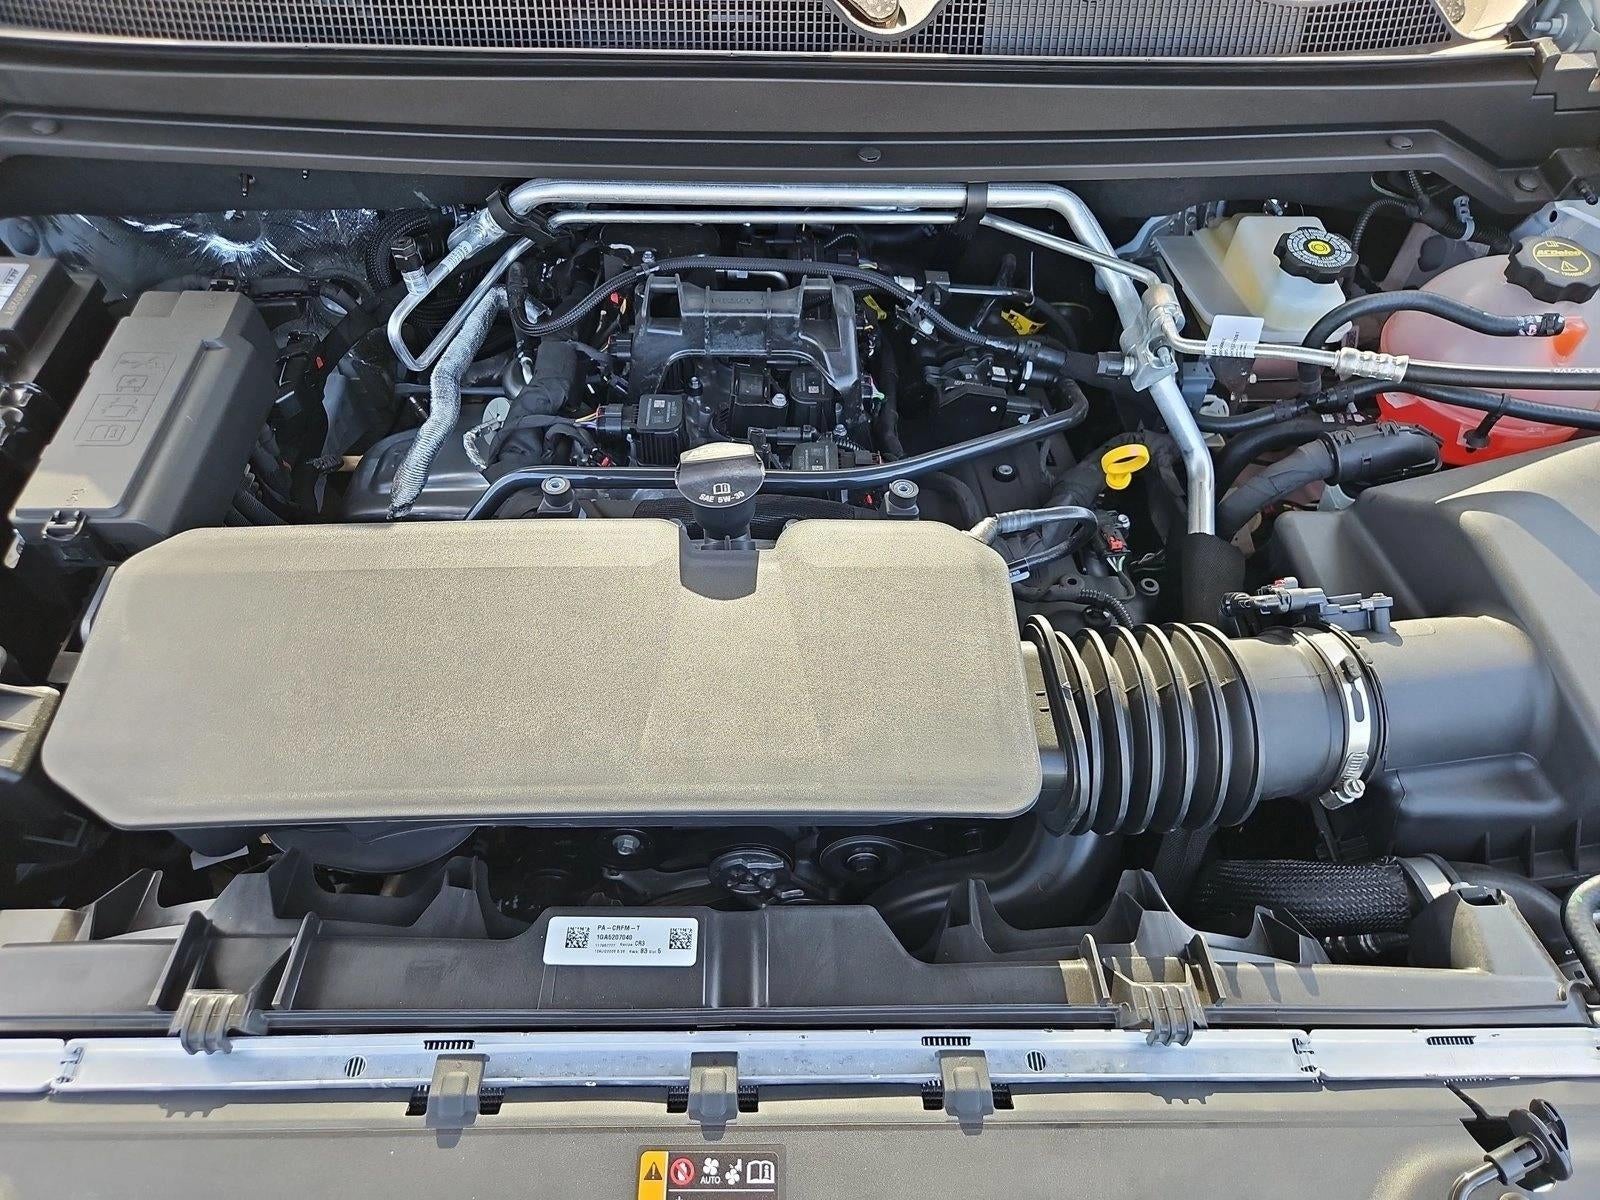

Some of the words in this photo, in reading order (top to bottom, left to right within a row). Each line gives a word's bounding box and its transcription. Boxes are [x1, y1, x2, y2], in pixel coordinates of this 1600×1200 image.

[1536, 249, 1582, 257] ACDelco
[698, 493, 715, 503] SAE
[717, 491, 746, 503] 5W-30
[699, 1175, 722, 1185] AUTO
